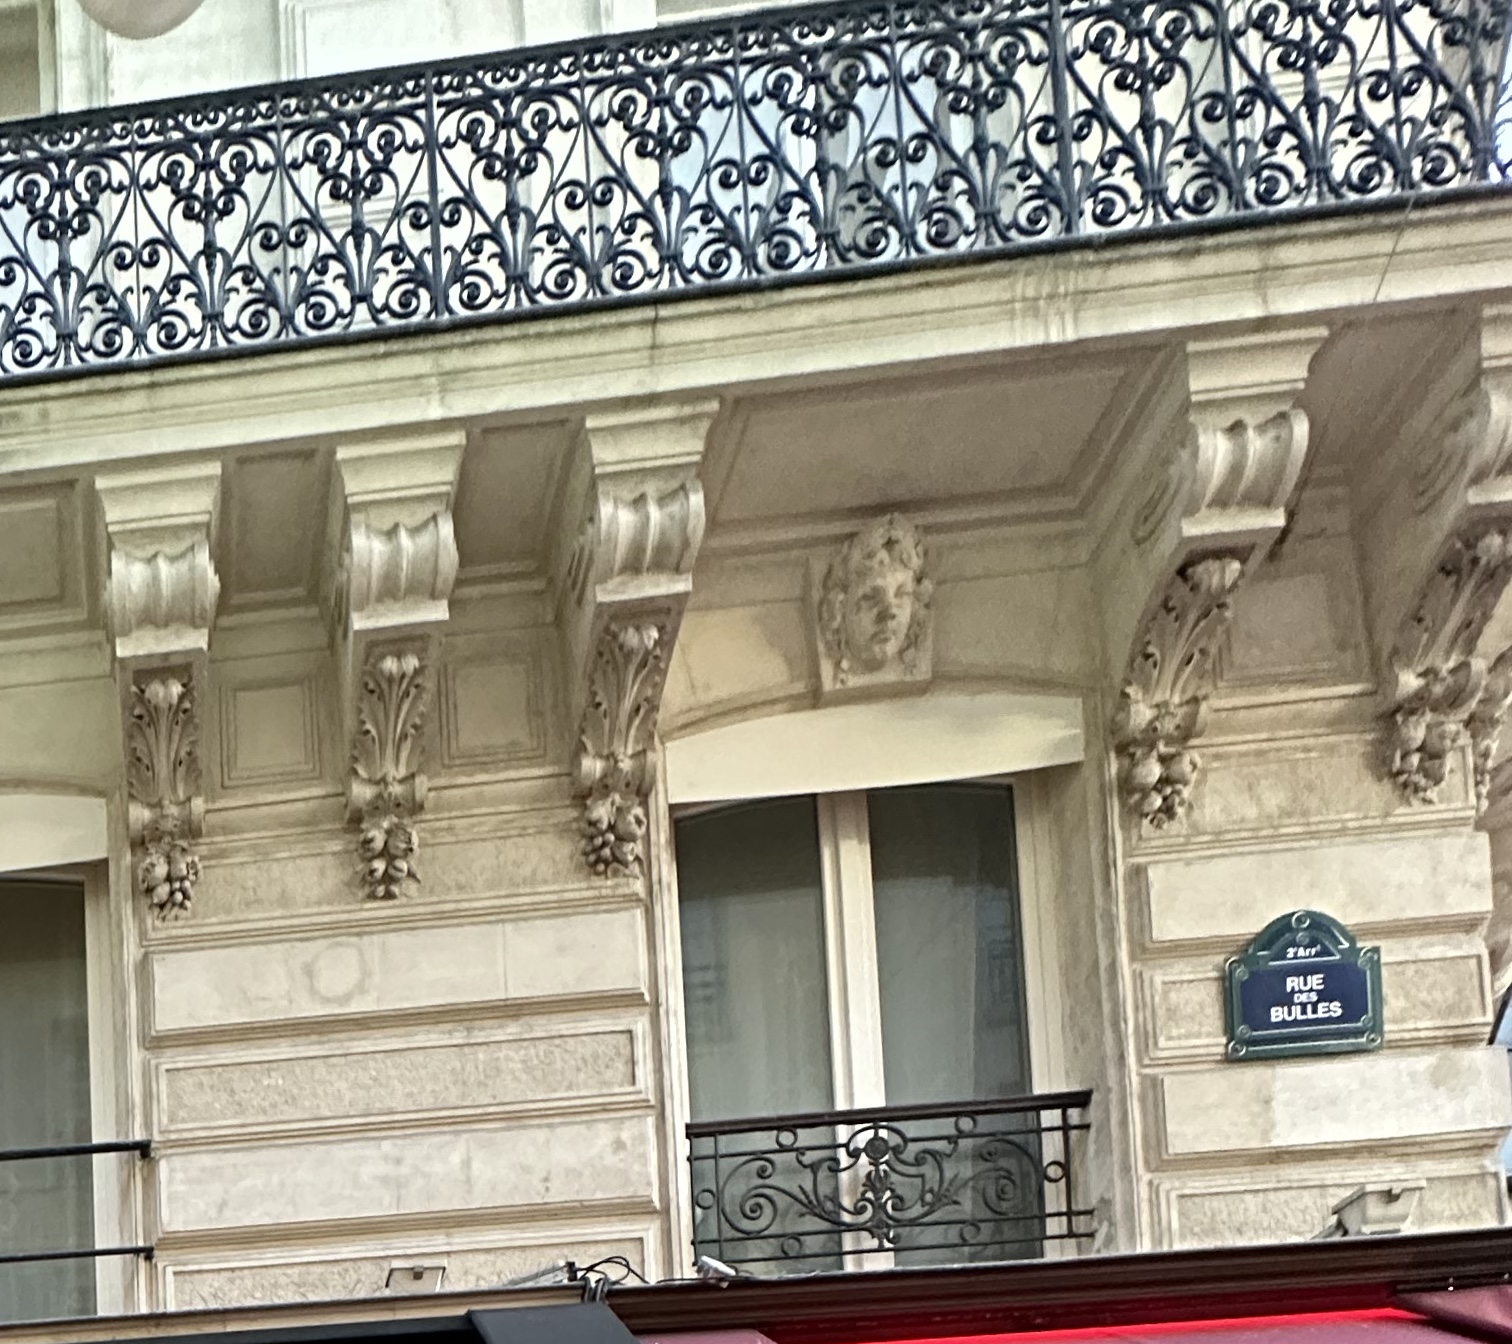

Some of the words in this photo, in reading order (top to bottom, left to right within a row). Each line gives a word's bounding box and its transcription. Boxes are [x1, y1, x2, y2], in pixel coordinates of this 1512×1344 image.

[1286, 974, 1325, 993] RUE
[1293, 991, 1319, 1003] DES
[1270, 1001, 1343, 1022] BULLES
